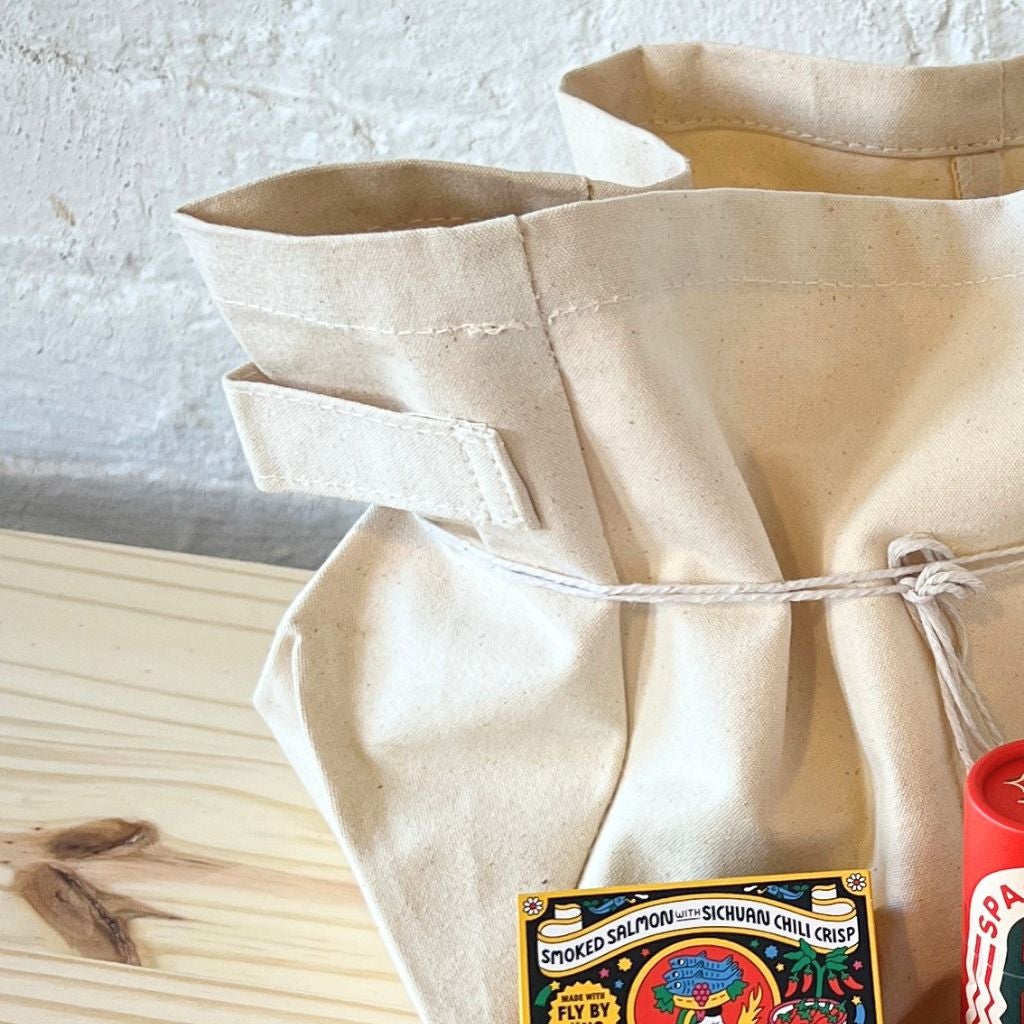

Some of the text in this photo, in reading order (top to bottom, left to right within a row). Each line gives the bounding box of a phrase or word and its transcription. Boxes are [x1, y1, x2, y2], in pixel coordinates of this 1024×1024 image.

[541, 905, 855, 964] SMOKED SALMON WITH SICHUAN CHILI CRISP
[561, 992, 605, 1002] MADE WITH
[558, 1002, 610, 1021] FLY BY
